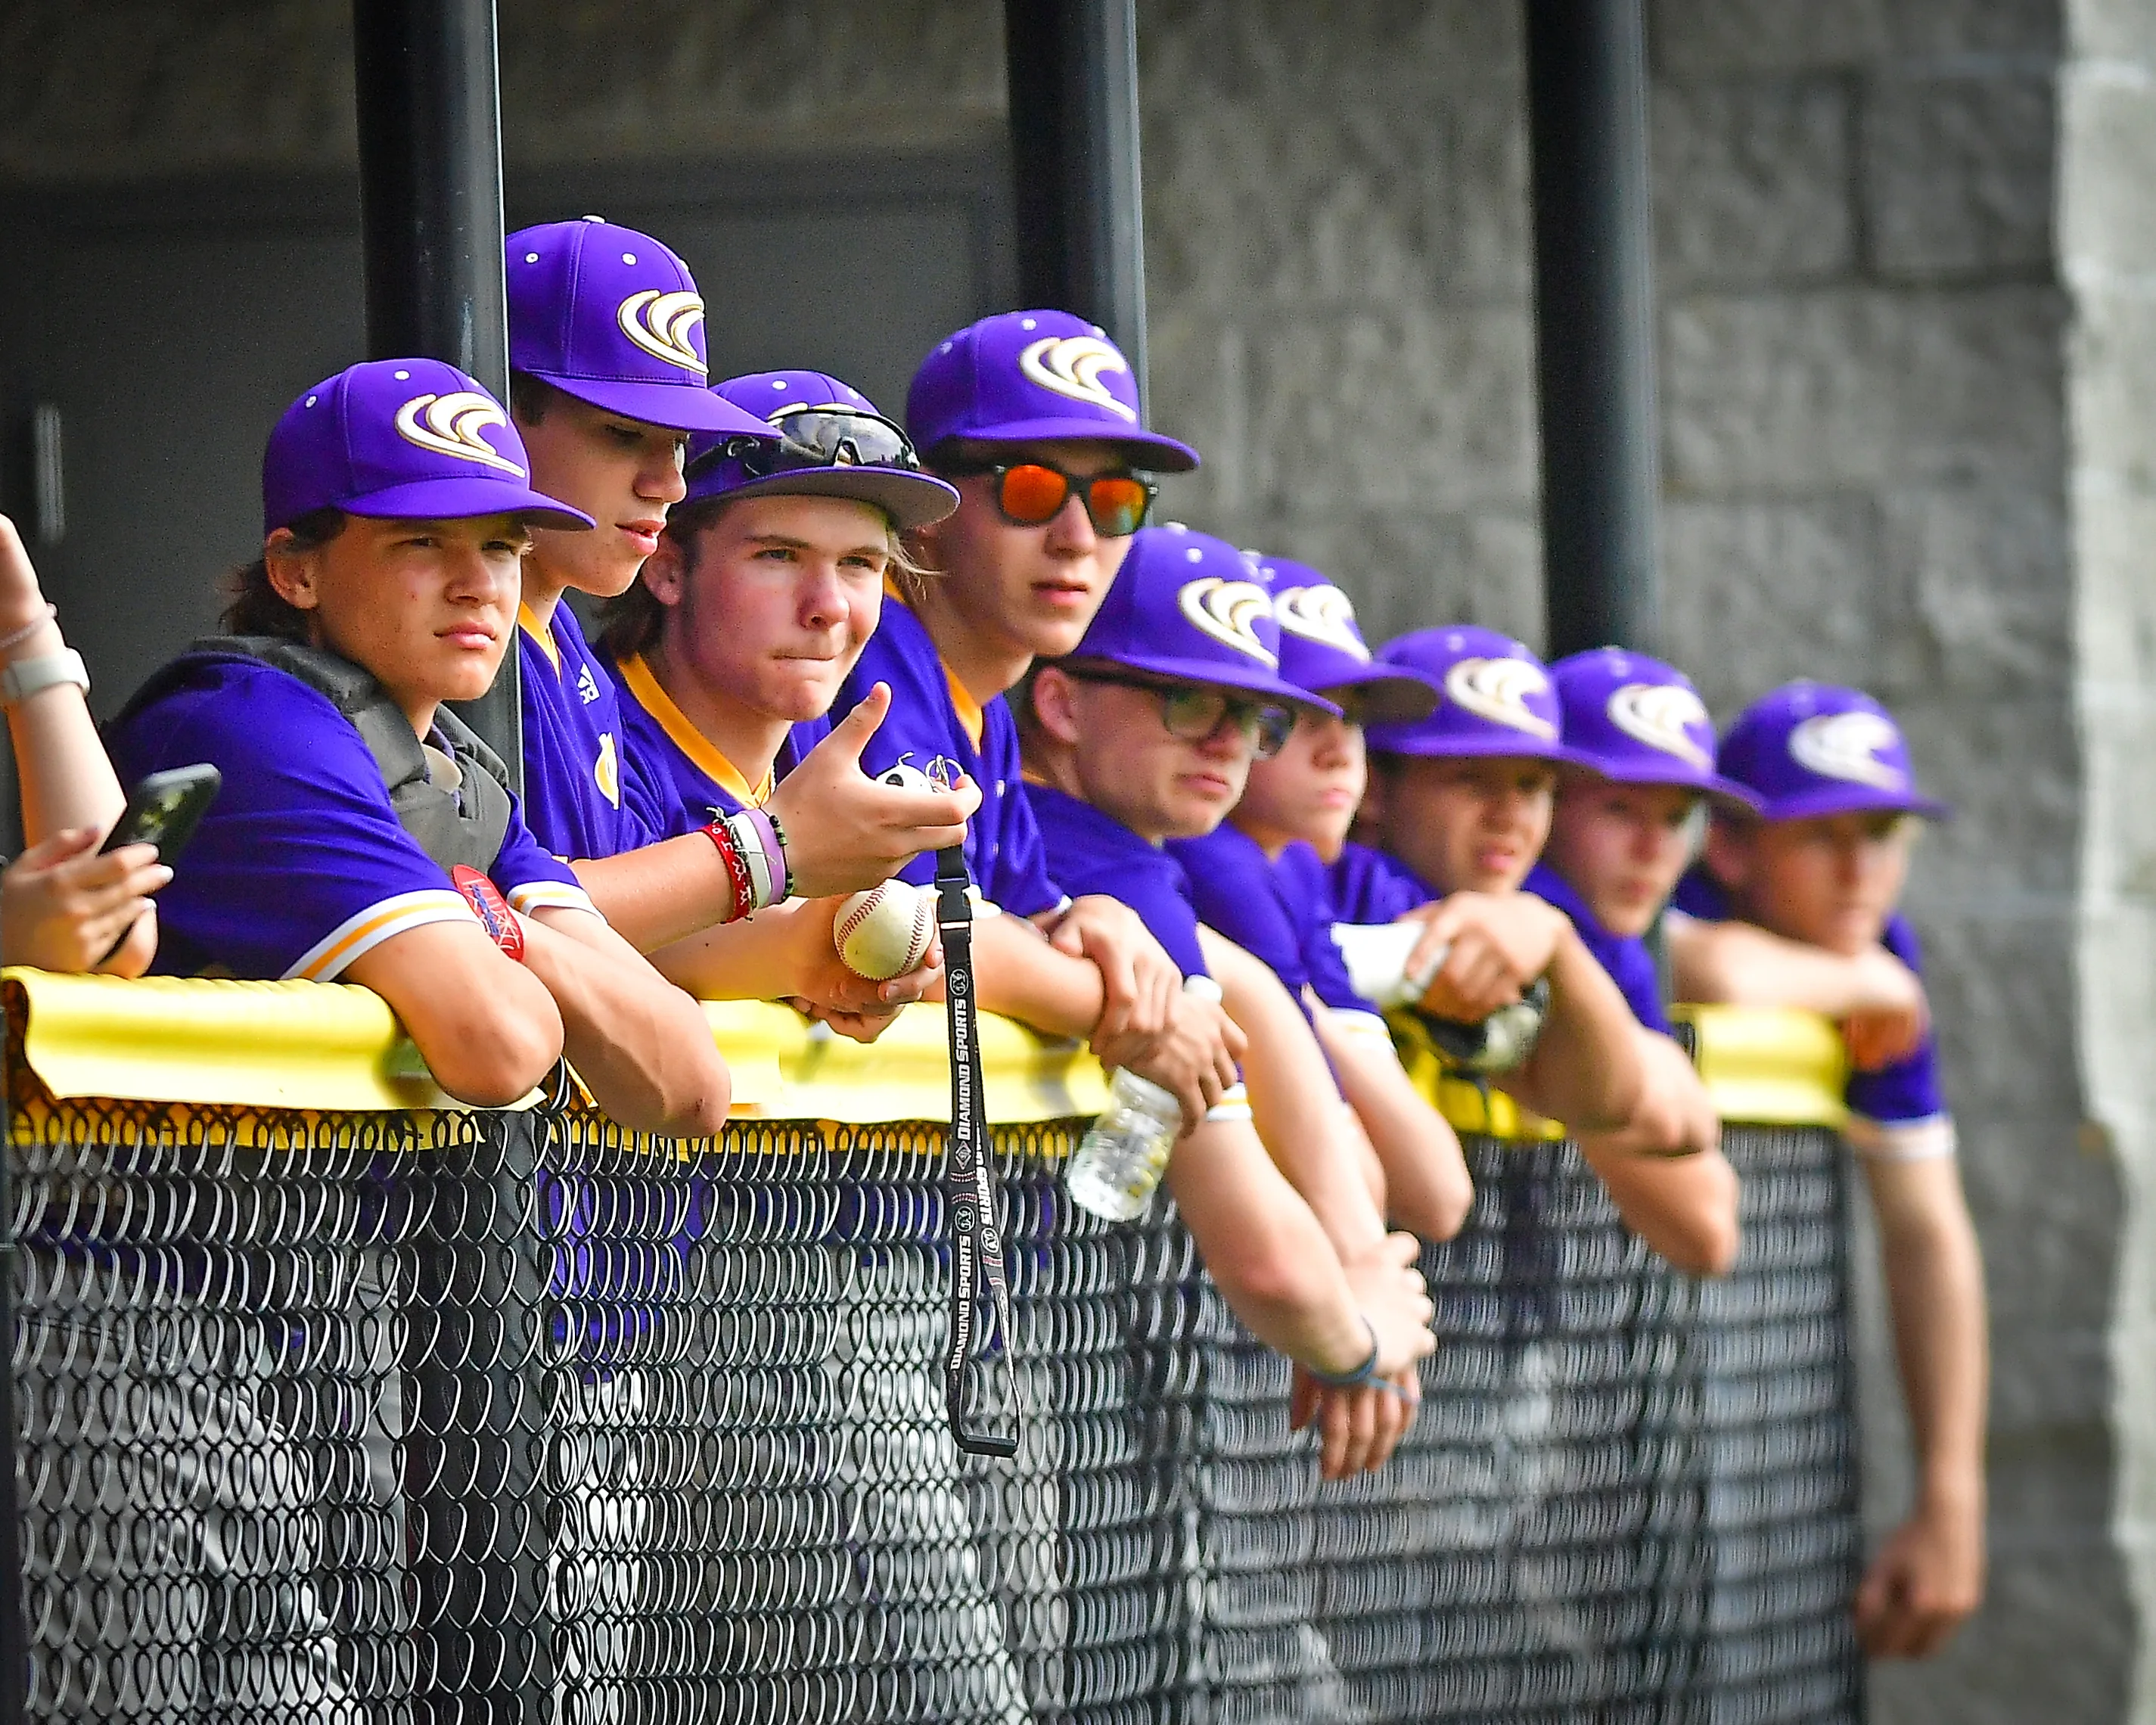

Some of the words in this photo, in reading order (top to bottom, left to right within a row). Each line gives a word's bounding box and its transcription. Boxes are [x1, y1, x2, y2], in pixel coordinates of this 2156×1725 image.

[954, 998, 969, 1062] SPORTS
[957, 1063, 971, 1141] DIAMOND
[958, 1234, 971, 1300] SPORTS
[950, 1300, 970, 1370] DIAMOND
